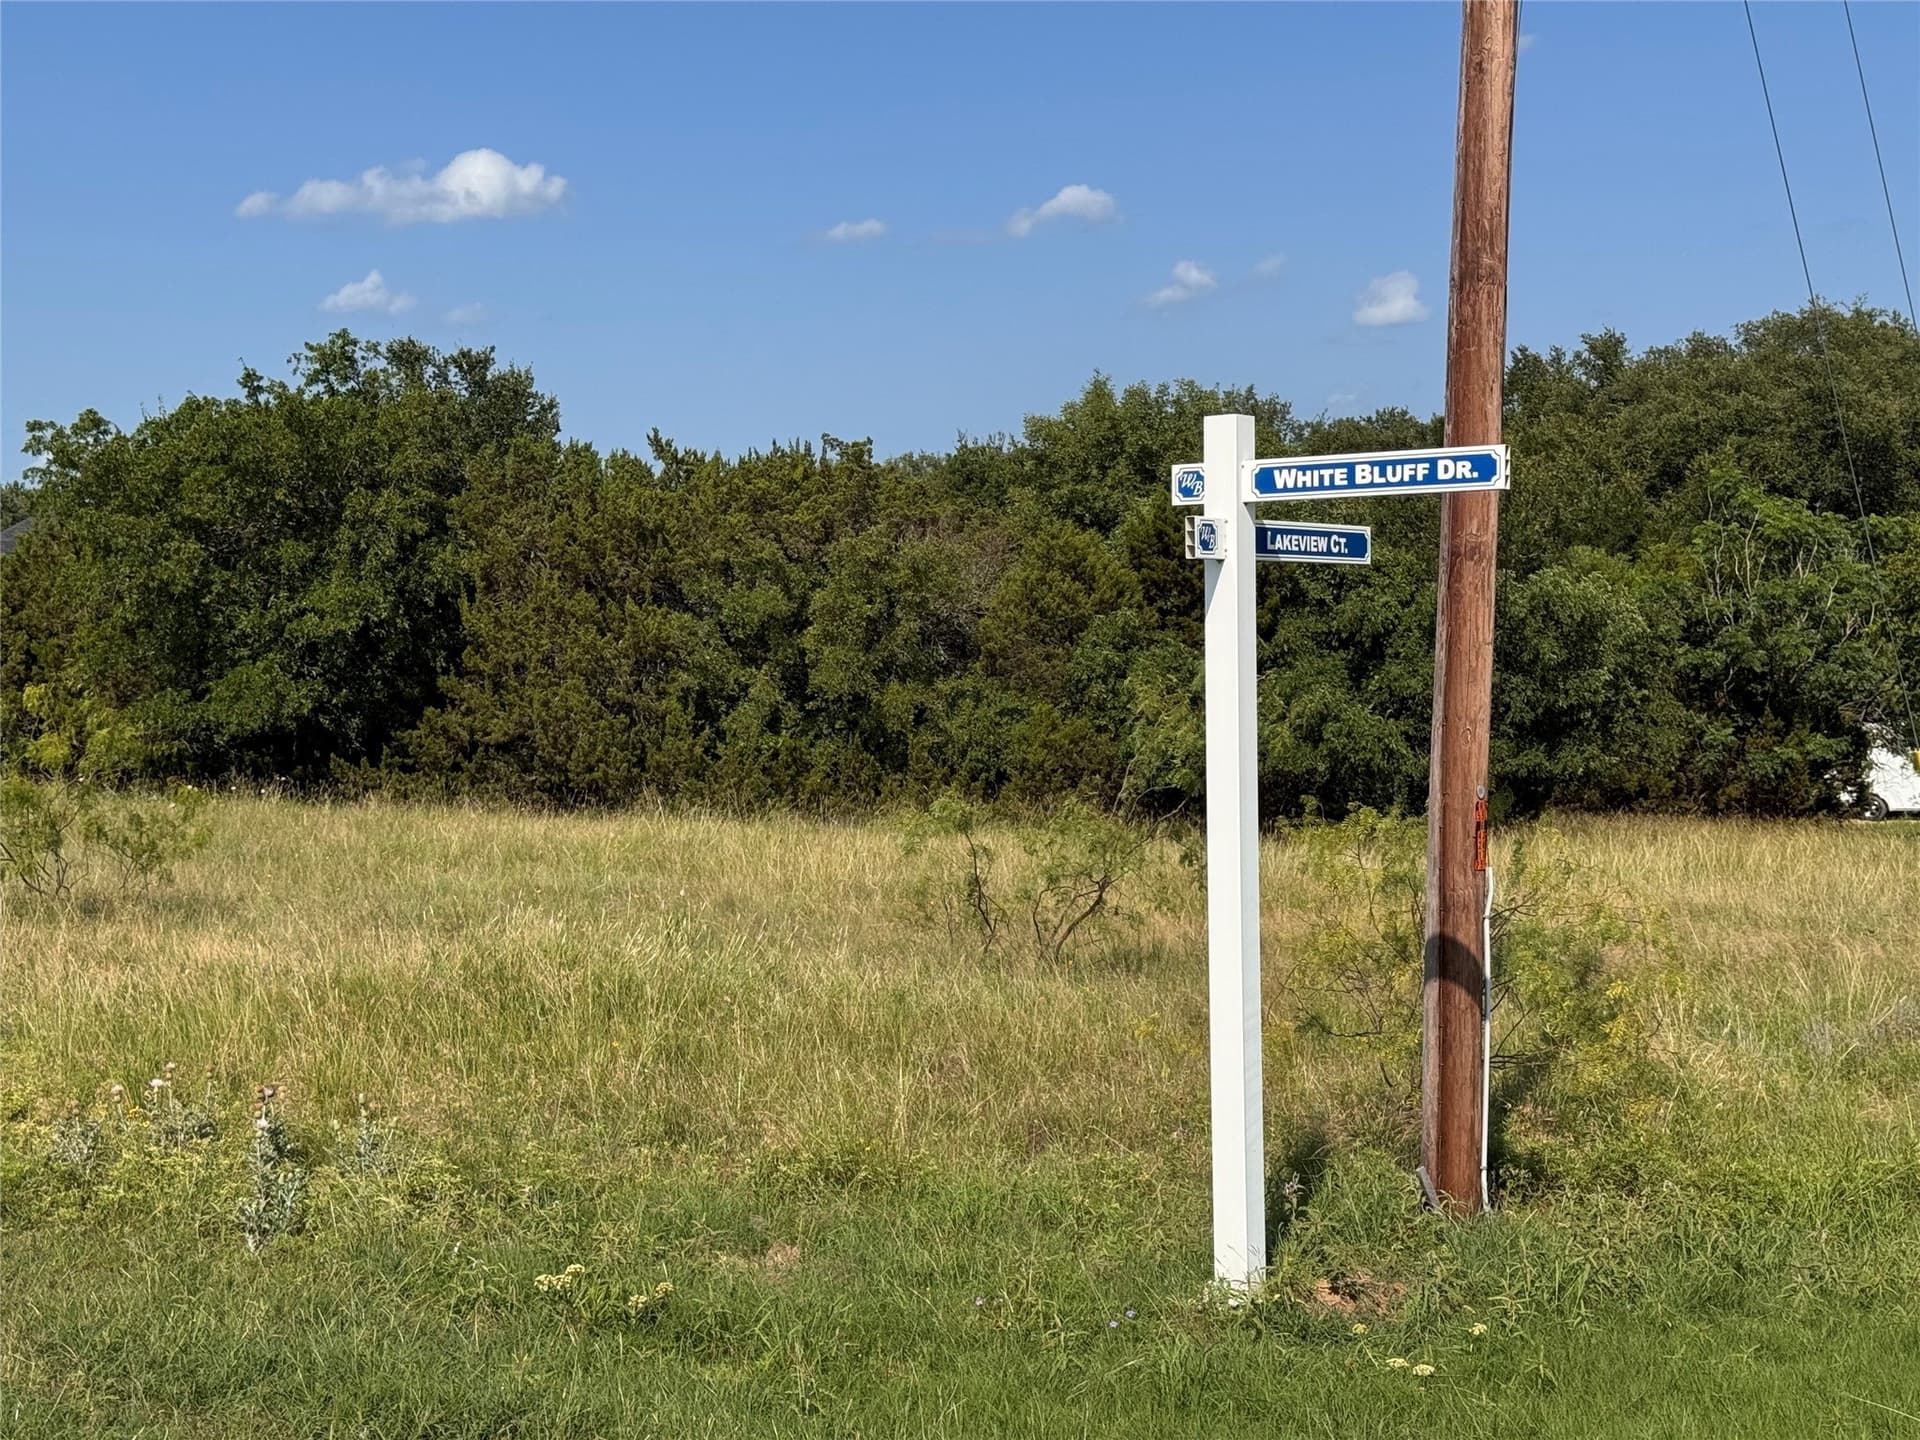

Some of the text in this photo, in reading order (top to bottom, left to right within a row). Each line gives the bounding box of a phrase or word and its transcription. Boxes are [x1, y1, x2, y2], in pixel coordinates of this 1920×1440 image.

[1273, 468, 1348, 489] WHITE
[1354, 464, 1430, 485] BLUFF
[1267, 531, 1327, 552] LAKEVIEW
